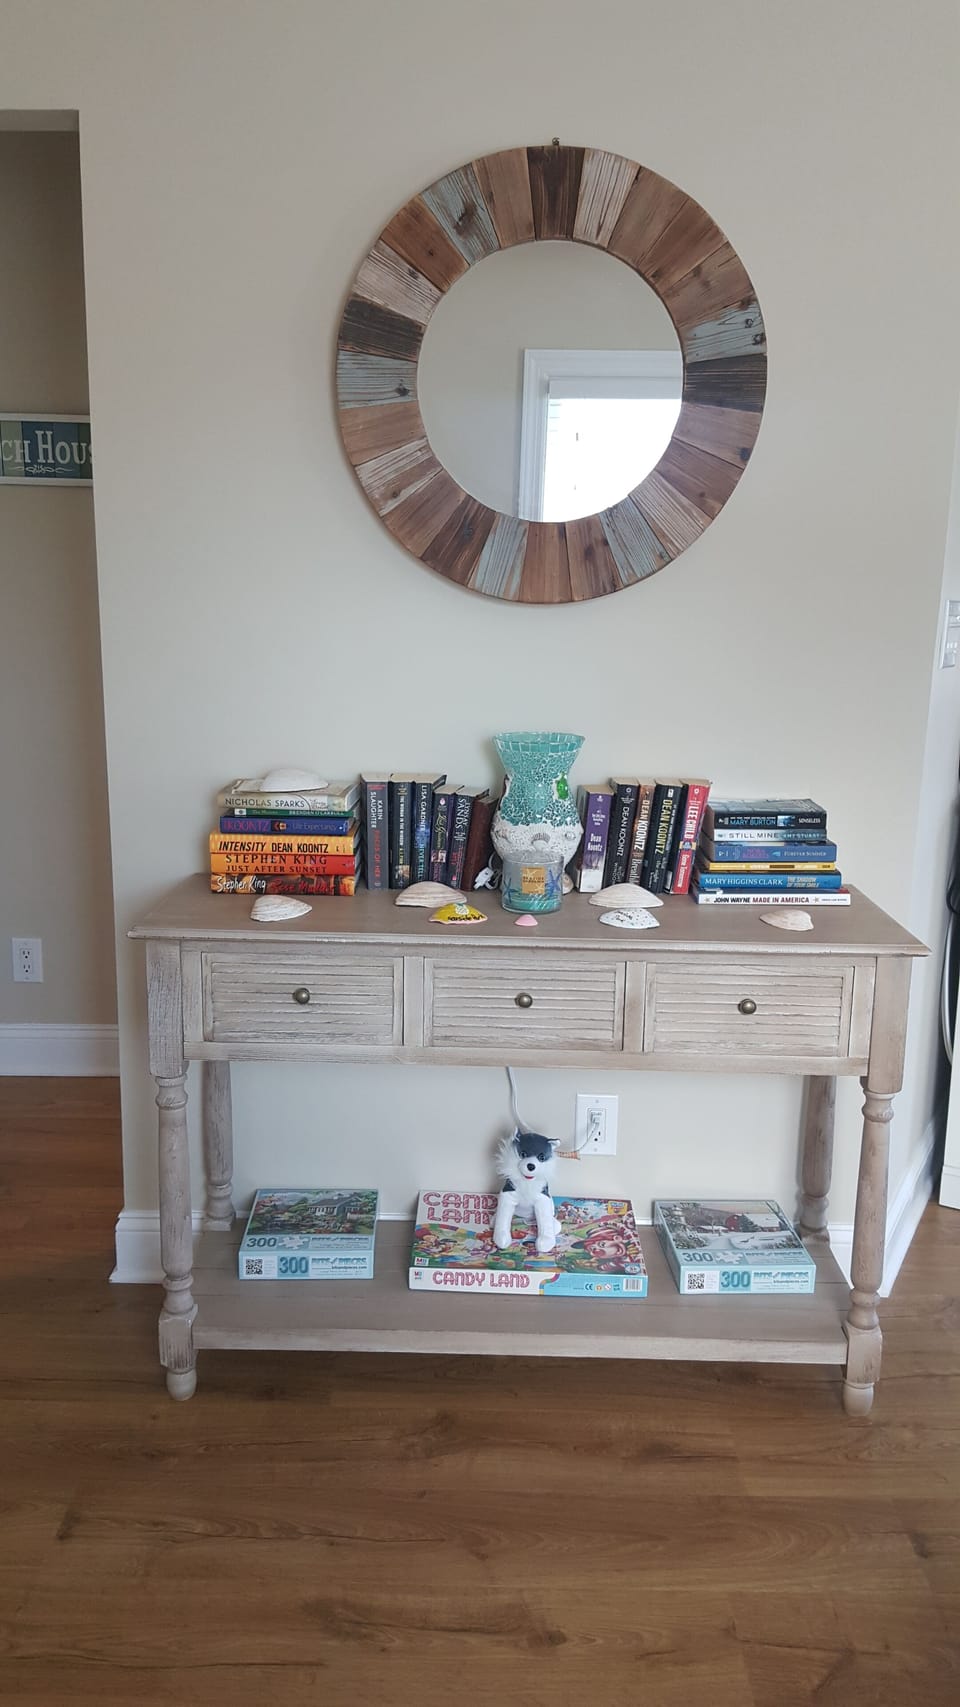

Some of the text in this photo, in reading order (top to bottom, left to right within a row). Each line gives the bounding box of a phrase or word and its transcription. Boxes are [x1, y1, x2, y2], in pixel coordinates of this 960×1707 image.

[35, 430, 92, 465] HOU
[225, 798, 272, 807] NICHOLAS
[275, 799, 305, 808] SPARKS
[640, 800, 649, 820] DEAN
[455, 798, 466, 829] SANDS
[462, 802, 470, 825] LYNSAY
[621, 806, 630, 827] DEAN
[688, 806, 699, 820] LEE
[634, 820, 648, 850] KOONTZ
[655, 799, 673, 855] DEAN KOONTZ
[684, 819, 697, 839] CHILD
[218, 841, 329, 854] INTENSITY DEAN KOONTZ
[616, 828, 626, 857] KOONTZ
[225, 854, 328, 865] STEPHEN KING
[629, 858, 643, 884] Breathl
[216, 875, 267, 893] Stephen King
[423, 1191, 498, 1210] CAND
[246, 1237, 277, 1248] 300
[279, 1256, 309, 1274] 300
[682, 1252, 714, 1262] 300
[432, 1270, 530, 1288] CANDY LAND
[720, 1271, 750, 1288] 300
